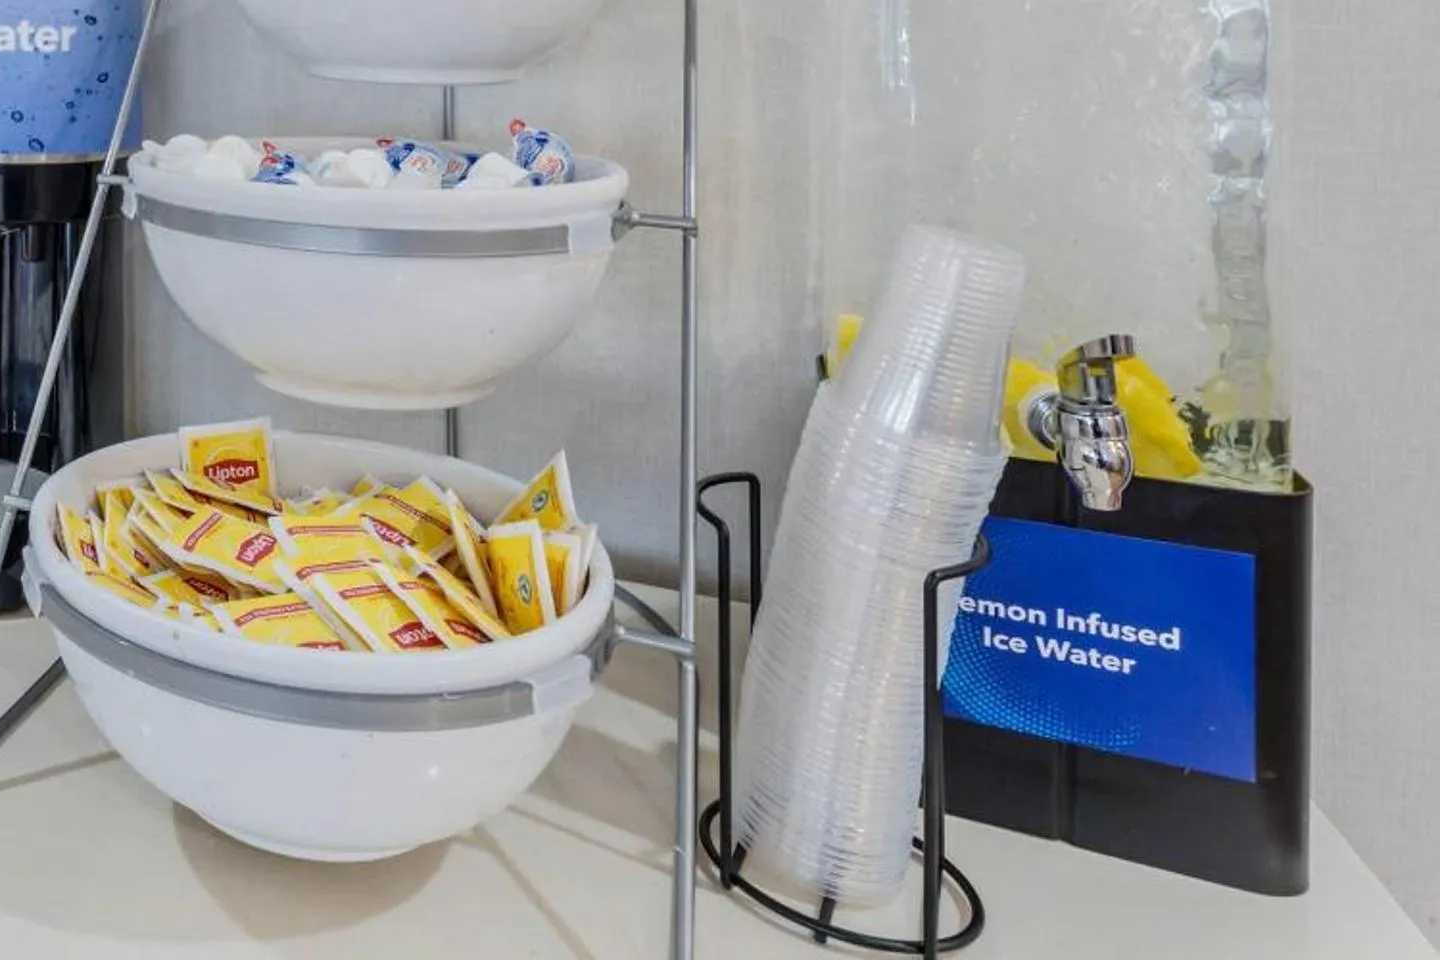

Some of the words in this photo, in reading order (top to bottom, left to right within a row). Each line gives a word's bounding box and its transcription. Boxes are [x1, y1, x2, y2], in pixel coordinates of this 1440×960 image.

[209, 465, 256, 480] Lipton
[959, 596, 1047, 626] emon
[1056, 609, 1181, 650] Infused
[983, 627, 1028, 653] Ice
[1035, 636, 1136, 674] Water
